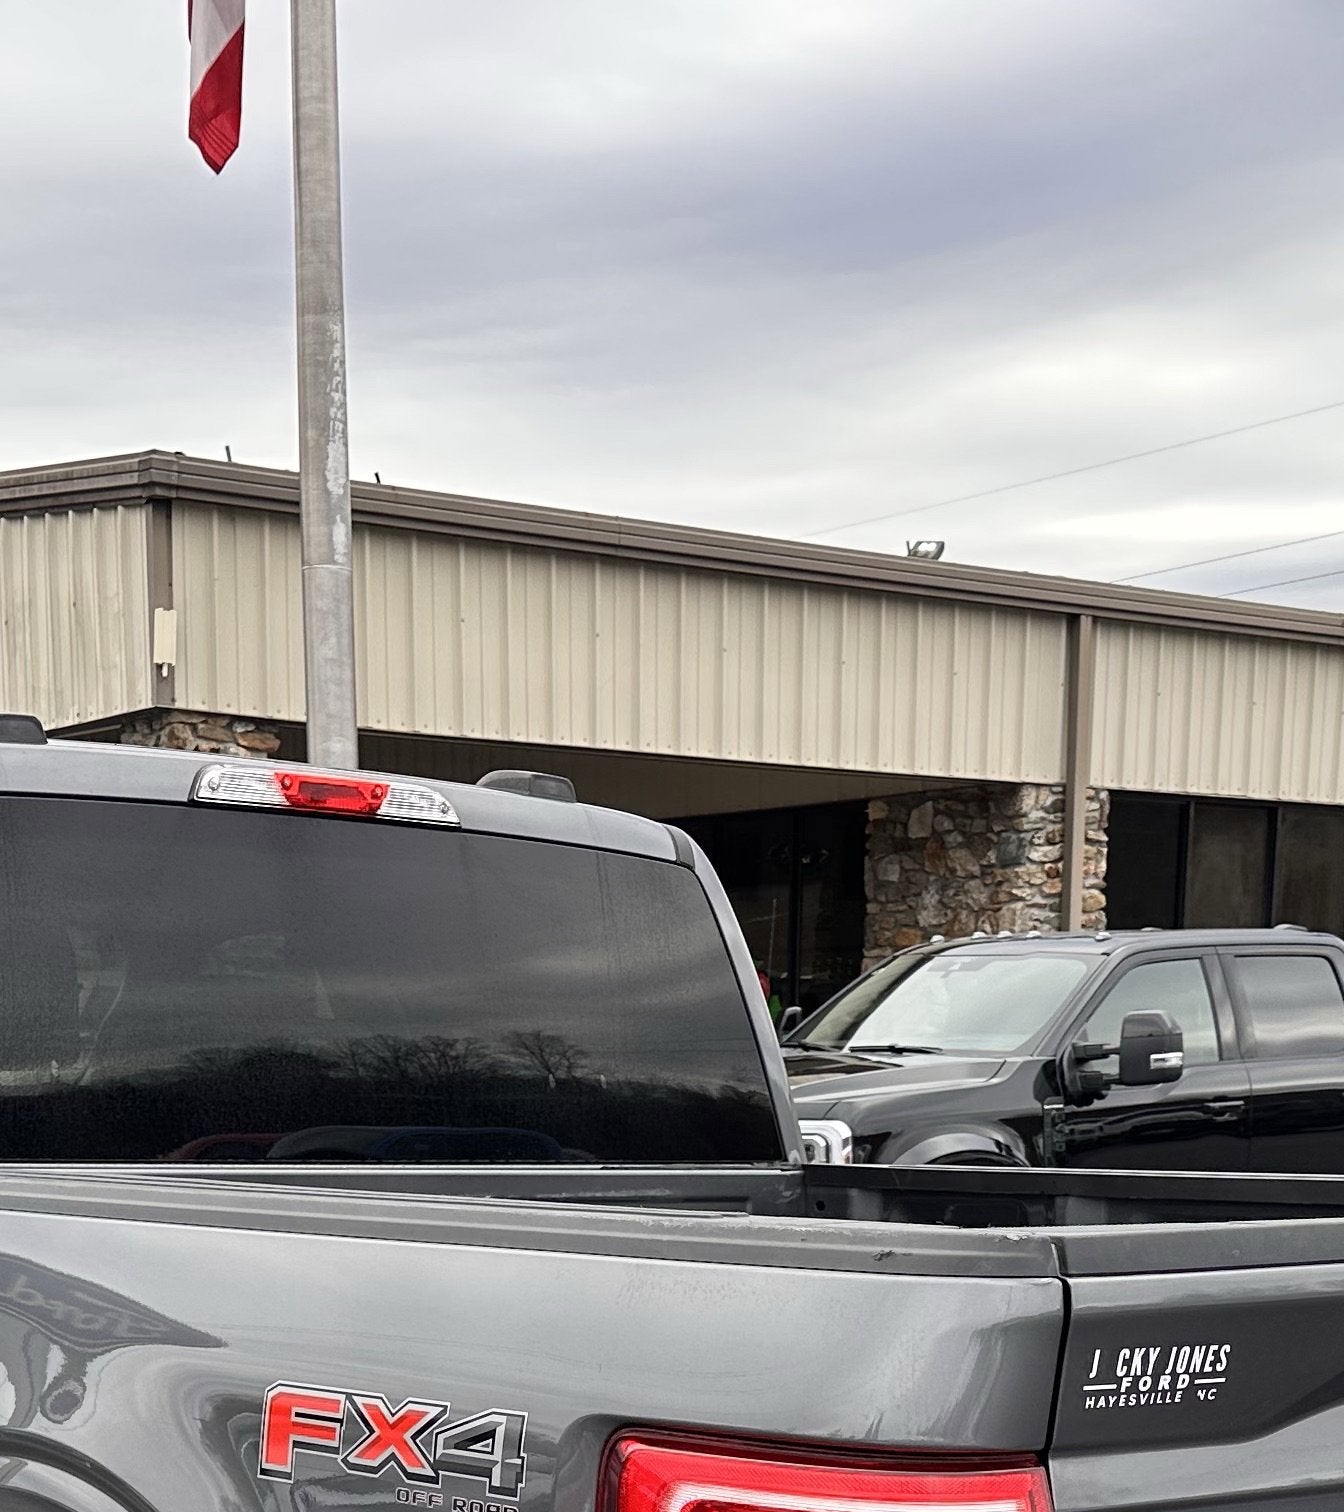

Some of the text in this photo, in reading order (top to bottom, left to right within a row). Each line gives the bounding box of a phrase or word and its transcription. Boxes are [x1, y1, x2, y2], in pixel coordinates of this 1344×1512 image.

[1089, 1344, 1231, 1379] JCKY JONES
[1120, 1374, 1190, 1393] FORD
[1084, 1388, 1218, 1410] HAYESVILLE NC
[257, 1380, 529, 1501] FX4
[395, 1487, 443, 1508] OFF
